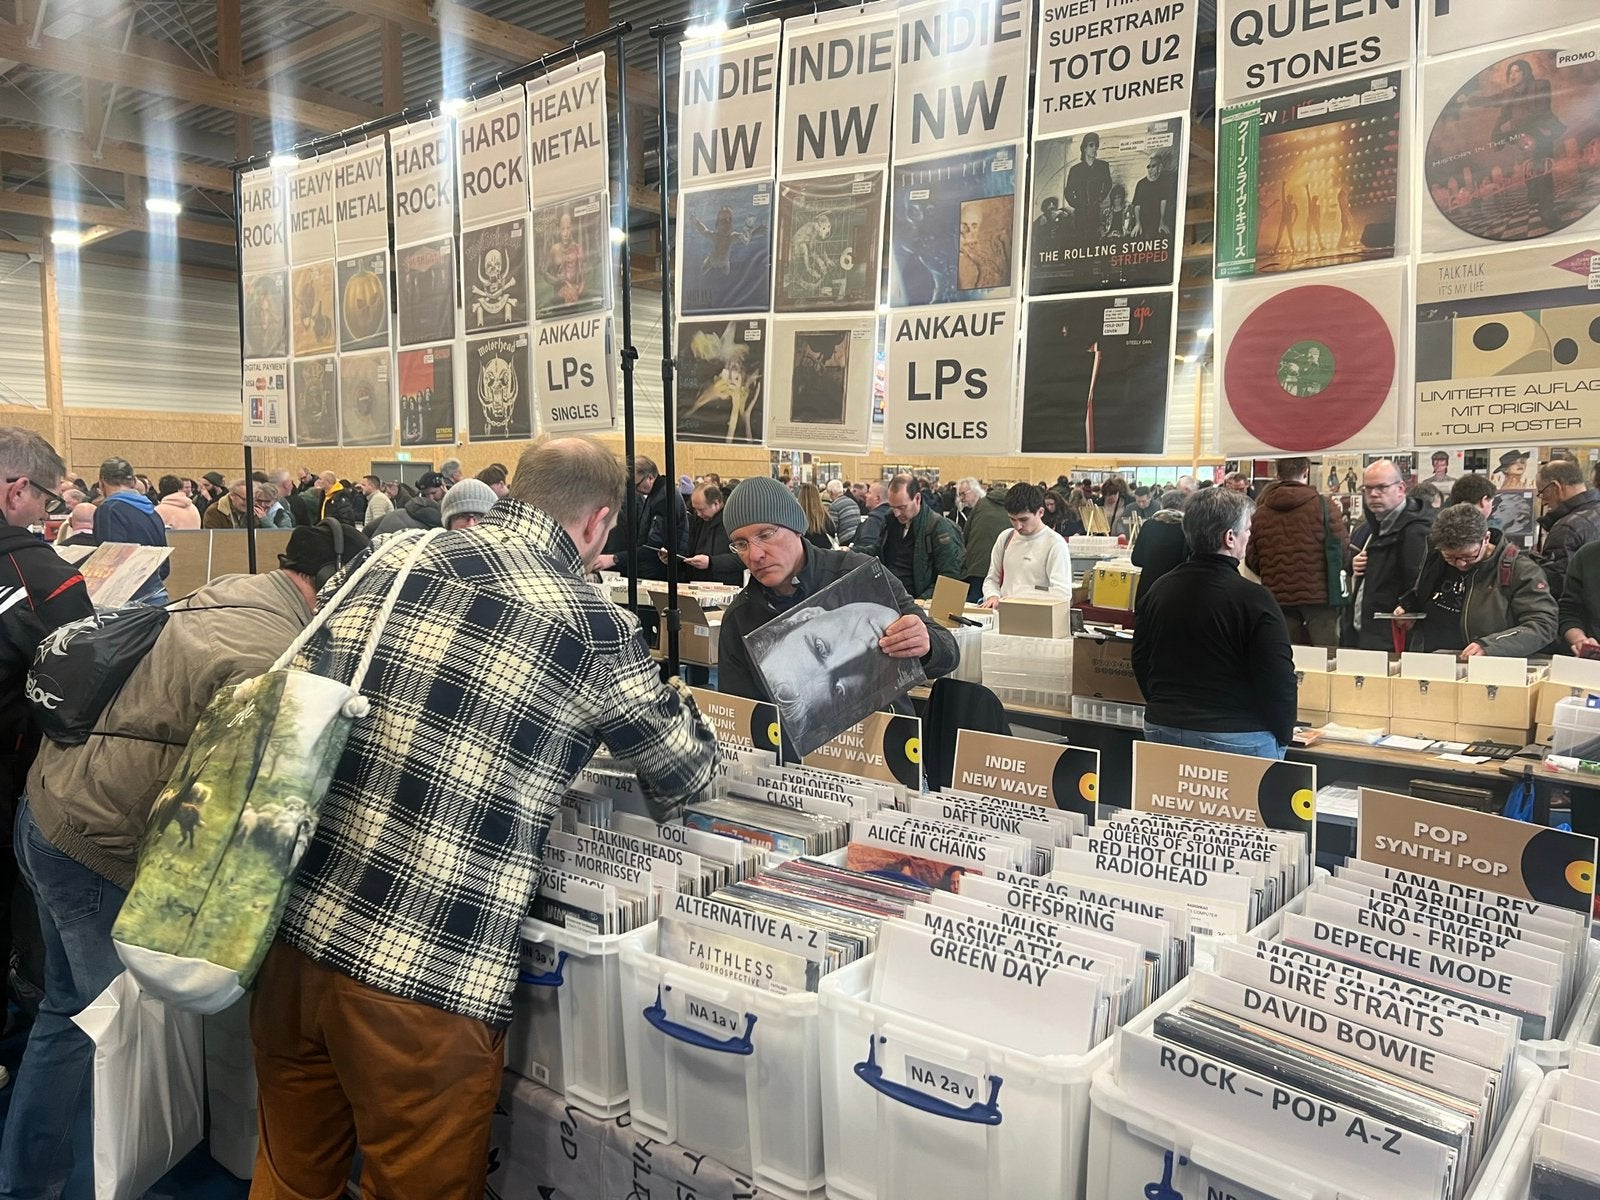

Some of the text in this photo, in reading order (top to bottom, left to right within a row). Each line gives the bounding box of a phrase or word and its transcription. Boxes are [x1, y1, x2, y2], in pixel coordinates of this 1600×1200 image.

[1044, 0, 1097, 23] SWEET
[1049, 2, 1184, 47] SUPERTRAMP
[901, 0, 1022, 64] INDIE
[788, 29, 894, 86] INDIE
[1049, 34, 1180, 83] TOTO U2
[1246, 36, 1381, 89] STONES
[1559, 51, 1596, 63] PROMO
[684, 53, 774, 106] INDIE
[1043, 73, 1184, 114] T.REX TURNER
[531, 77, 600, 126] HEAVY
[912, 75, 1007, 144] NW
[462, 112, 520, 156] HARD
[533, 122, 601, 166] METAL
[692, 121, 762, 176] NW
[796, 104, 879, 162] NW
[335, 155, 384, 188] HEAVY
[396, 138, 448, 176] HARD
[289, 169, 333, 200] HEAVY
[463, 155, 523, 199] ROCK
[243, 185, 283, 213] HARD
[336, 191, 385, 222] METAL
[397, 180, 450, 217] ROCK
[243, 221, 283, 248] ROCK
[291, 205, 333, 232] METAL
[1039, 239, 1169, 262] THE ROLLING STONES
[1111, 251, 1168, 267] STRIPPED
[1439, 263, 1485, 281] TALK TALK
[1439, 281, 1484, 296] IT'S MY LIFE
[538, 318, 601, 346] ANKAUF
[896, 311, 1006, 342] ANKAUF
[245, 363, 261, 372] DIGITAL
[547, 356, 594, 391] LPs
[908, 359, 988, 401] LPs
[1421, 379, 1600, 403] LIMITIERTE AUFLAG
[552, 404, 599, 421] SINGLES
[1452, 400, 1577, 417] MIT ORIGINAL
[244, 434, 287, 444] DIGITAL PAYMENT
[905, 421, 988, 440] SINGLES
[1442, 417, 1582, 435] TOUR POSTER
[708, 703, 735, 718] INDIE
[719, 732, 750, 746] WAVE
[833, 734, 865, 748] PUNK
[813, 745, 883, 766] NEW WAVE
[985, 754, 1026, 773] INDIE
[582, 770, 632, 793] FRONT 242
[962, 771, 1048, 798] NEW WAVE
[1178, 763, 1229, 783] INDIE
[757, 777, 854, 808] DEAD KENNEDYS
[767, 790, 803, 809] CLASH
[1178, 780, 1229, 800] PUNK
[943, 806, 977, 824] DAFT
[981, 814, 1021, 834] PUNK
[1151, 793, 1257, 822] NEW WAVE
[591, 828, 683, 865] TALKING HEADS
[656, 824, 688, 845] TOOL
[868, 824, 986, 861] ALICE IN CHAINS
[1103, 829, 1271, 863] QUEENS OF STONE AGE
[1413, 821, 1468, 846] POP
[575, 854, 641, 884] MORRISSEY
[578, 838, 652, 872] STRANGLERS
[1088, 839, 1122, 857] RED
[1128, 844, 1165, 863] HOT
[1171, 850, 1217, 872] CHILI
[1095, 854, 1208, 888] RADIOHEAD
[1375, 835, 1508, 878] SYNTH POP
[1080, 889, 1164, 919] MACHINE
[1385, 867, 1540, 915] LANA DEL REY
[1392, 882, 1519, 928] MARILLION
[675, 895, 818, 948] ALTERNATIVE A Z
[1002, 913, 1058, 937] MUSE
[1007, 889, 1114, 932] OFFSPRING
[1368, 897, 1511, 950] KRAFTWERK
[924, 913, 1007, 947] MASSIVE
[1014, 939, 1095, 971] ATTACK
[1358, 908, 1496, 962] ENO FRIPP
[689, 940, 773, 980] FAITHLESS
[699, 960, 760, 988] OUTROSPECTIVE
[930, 937, 997, 973] GREEN
[1002, 957, 1049, 987] DAY
[1314, 921, 1422, 970] DEPECHE
[1429, 954, 1513, 995] MODE
[690, 1002, 737, 1031] NA 1a v
[1269, 964, 1327, 1000] DIRE
[1334, 985, 1445, 1038] STRAITS
[1244, 987, 1327, 1034] DAVID
[1336, 1021, 1437, 1074] BOWIE
[911, 1064, 975, 1100] NA 2a v
[1160, 1046, 1403, 1156] ROCK POP A-Z
